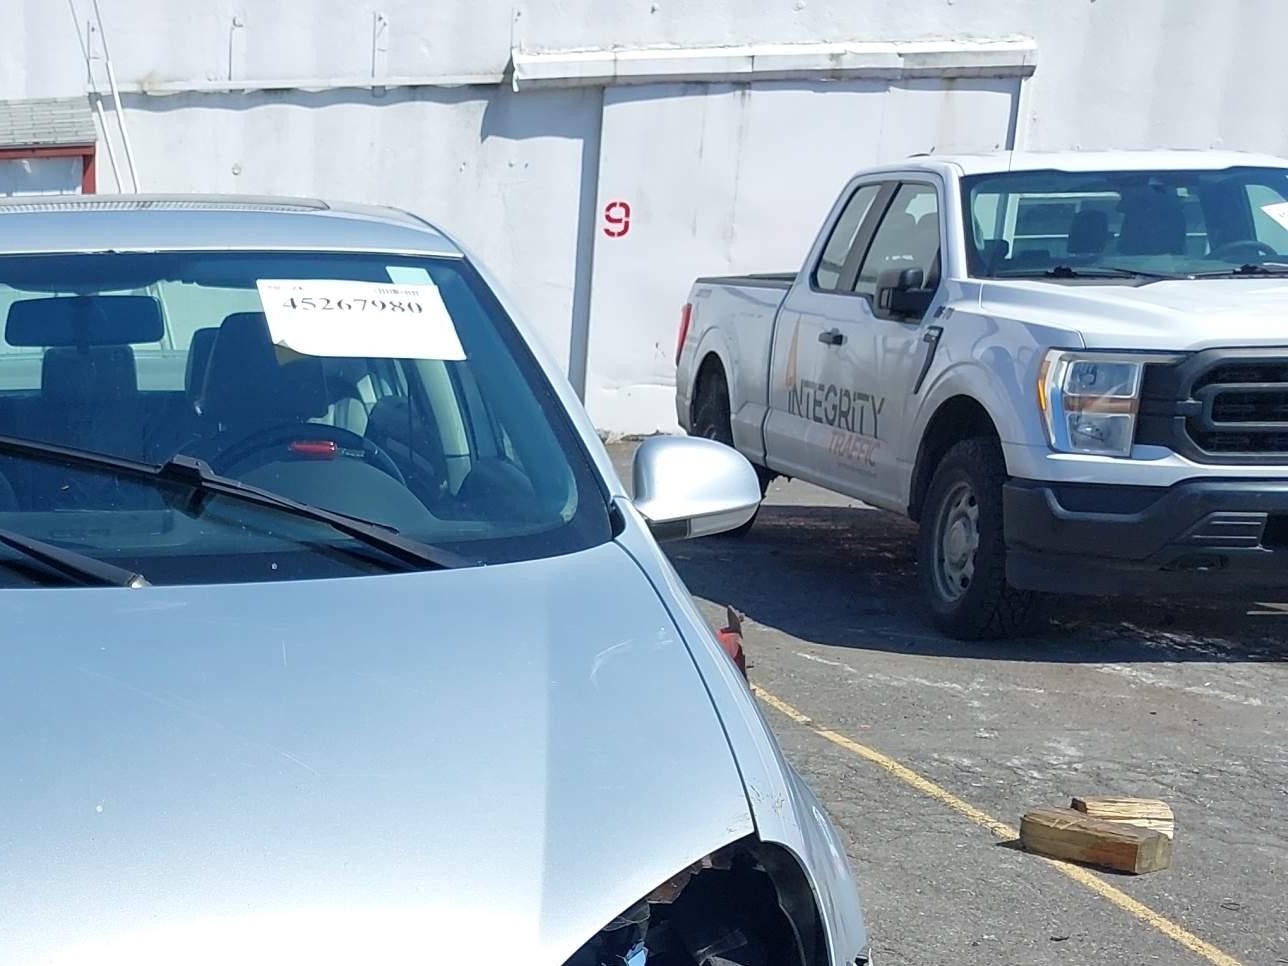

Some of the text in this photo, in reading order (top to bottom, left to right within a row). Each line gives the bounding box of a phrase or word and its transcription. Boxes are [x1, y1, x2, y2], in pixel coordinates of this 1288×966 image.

[603, 201, 630, 237] 9
[283, 297, 423, 314] 45267980
[787, 379, 885, 440] INTEGRITY
